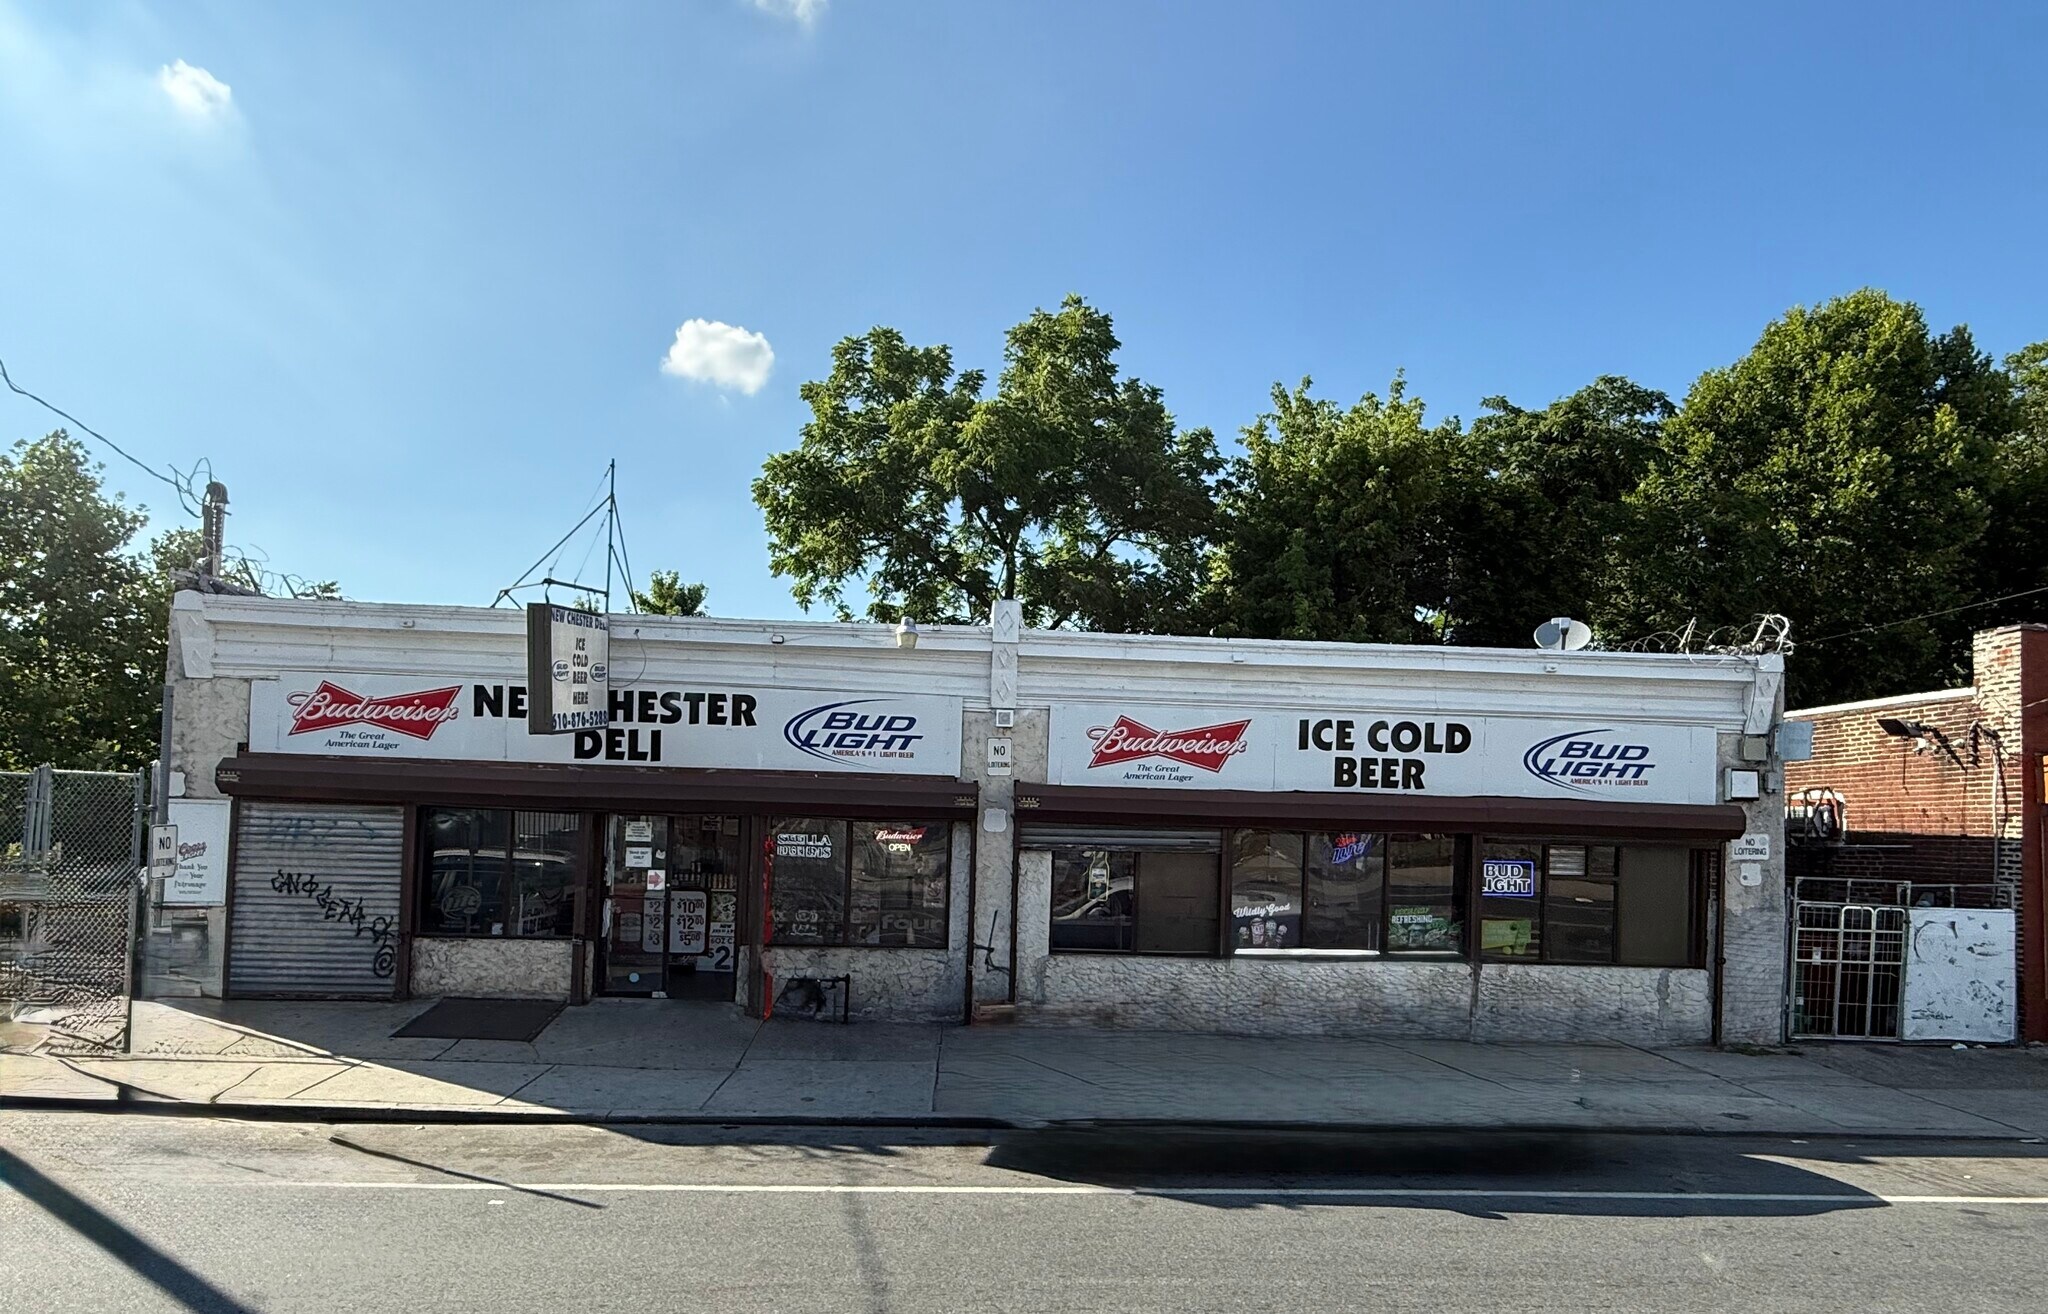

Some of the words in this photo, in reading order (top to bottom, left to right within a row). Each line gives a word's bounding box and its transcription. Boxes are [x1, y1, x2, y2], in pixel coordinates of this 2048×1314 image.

[567, 611, 593, 628] CHESTER
[575, 637, 586, 651] ICE
[572, 653, 588, 667] COLD
[572, 671, 588, 684] BEER
[572, 691, 588, 705] HERE
[286, 691, 459, 722] Budweiser
[473, 685, 528, 719] NE
[609, 690, 757, 726] HESTER
[821, 712, 917, 731] BUD
[340, 731, 356, 740] The
[359, 732, 385, 740] Great
[800, 730, 924, 750] LIGHT
[1086, 725, 1248, 755] Budweiser
[1298, 719, 1355, 751] ICE
[1367, 720, 1472, 754] COLD
[324, 740, 370, 748] American
[372, 741, 400, 750] Lager
[574, 729, 661, 762] DELI
[993, 746, 1006, 756] NO
[1559, 741, 1650, 760] BUD
[1137, 764, 1152, 772] The
[1154, 765, 1180, 773] Great
[1334, 756, 1426, 790] BEER
[1538, 758, 1656, 778] LIGHT
[1123, 772, 1166, 780] American
[1168, 773, 1194, 782] Lager
[874, 829, 923, 840] Budweiser
[158, 836, 171, 850] NO
[888, 843, 911, 852] OPEN
[1745, 838, 1755, 846] NO
[1734, 847, 1767, 856] LOITERING
[1484, 864, 1524, 878] BUD
[1233, 905, 1267, 918] Wildly
[1265, 903, 1290, 916] Good
[1391, 915, 1433, 924] REFRESHING
